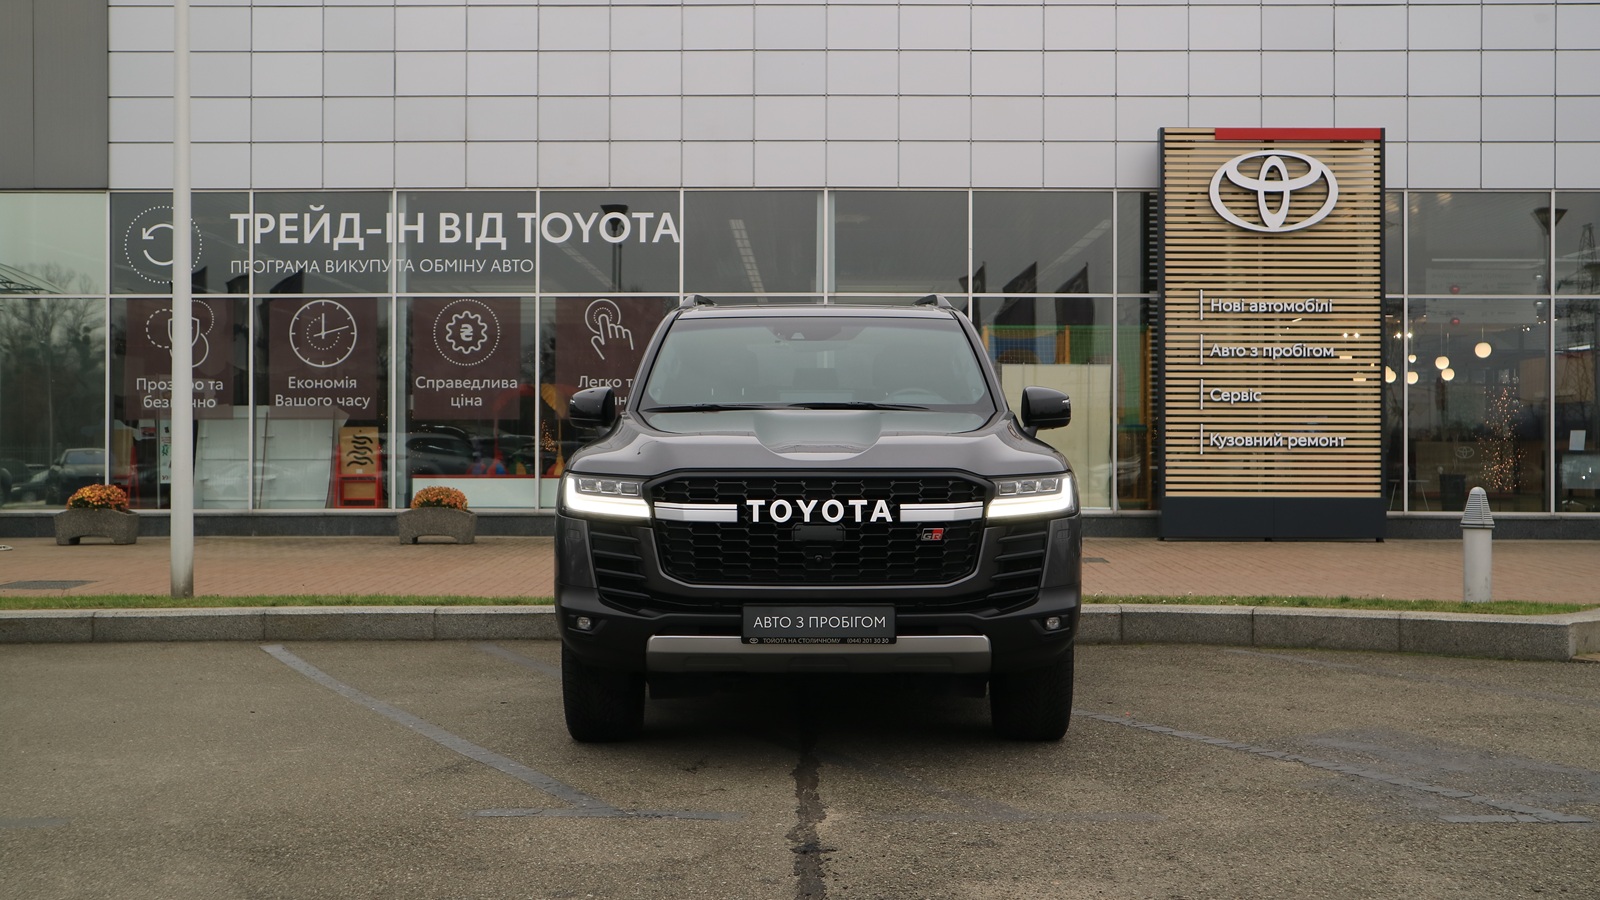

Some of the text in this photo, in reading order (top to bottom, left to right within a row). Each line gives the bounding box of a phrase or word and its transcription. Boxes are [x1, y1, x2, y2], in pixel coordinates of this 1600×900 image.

[230, 205, 680, 251] ТРЕЙД-ІН ВІД TOYOTA
[231, 259, 534, 273] ПРОГРАМА ВИКУПУ ТА ОБМІНУ АВТО
[1210, 298, 1333, 312] Нові автомобілі
[1210, 343, 1335, 360] Авто з пробігом
[136, 378, 224, 393] Прозо та
[288, 376, 357, 389] Економія
[415, 376, 518, 391] Справедлива
[578, 375, 634, 388] Легко т
[143, 395, 216, 408] безно
[275, 394, 370, 409] Вашого часу
[450, 393, 483, 408] ціна
[1210, 388, 1262, 404] Сервіс
[1209, 432, 1347, 449] Кузовний ремонт
[746, 499, 893, 523] TOYOTA
[922, 529, 943, 540] GR
[753, 616, 886, 628] АВТО З ПРОБІГОМ
